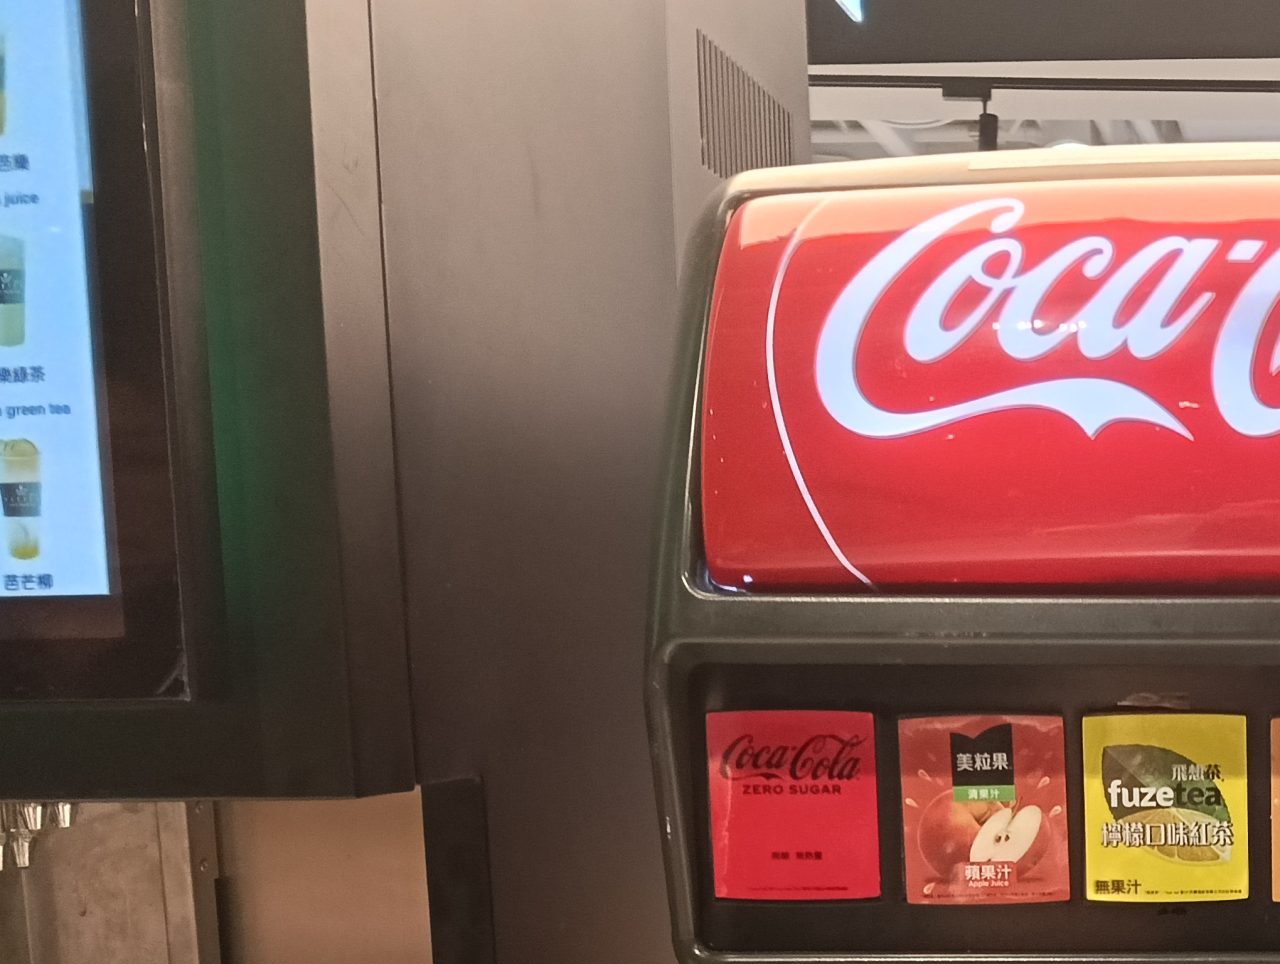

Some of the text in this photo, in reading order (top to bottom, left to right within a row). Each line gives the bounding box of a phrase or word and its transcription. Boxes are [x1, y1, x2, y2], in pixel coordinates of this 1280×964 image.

[6, 403, 72, 420] green tea
[720, 734, 867, 781] Coca-Cola
[956, 752, 1009, 772] 美粒果
[742, 784, 841, 795] ZERO SUGAR
[1101, 822, 1234, 848] 檸檬口味紅茶
[964, 864, 1012, 881] 蘋果汁
[968, 880, 989, 888] Apple
[1095, 879, 1142, 895] 無果汁
